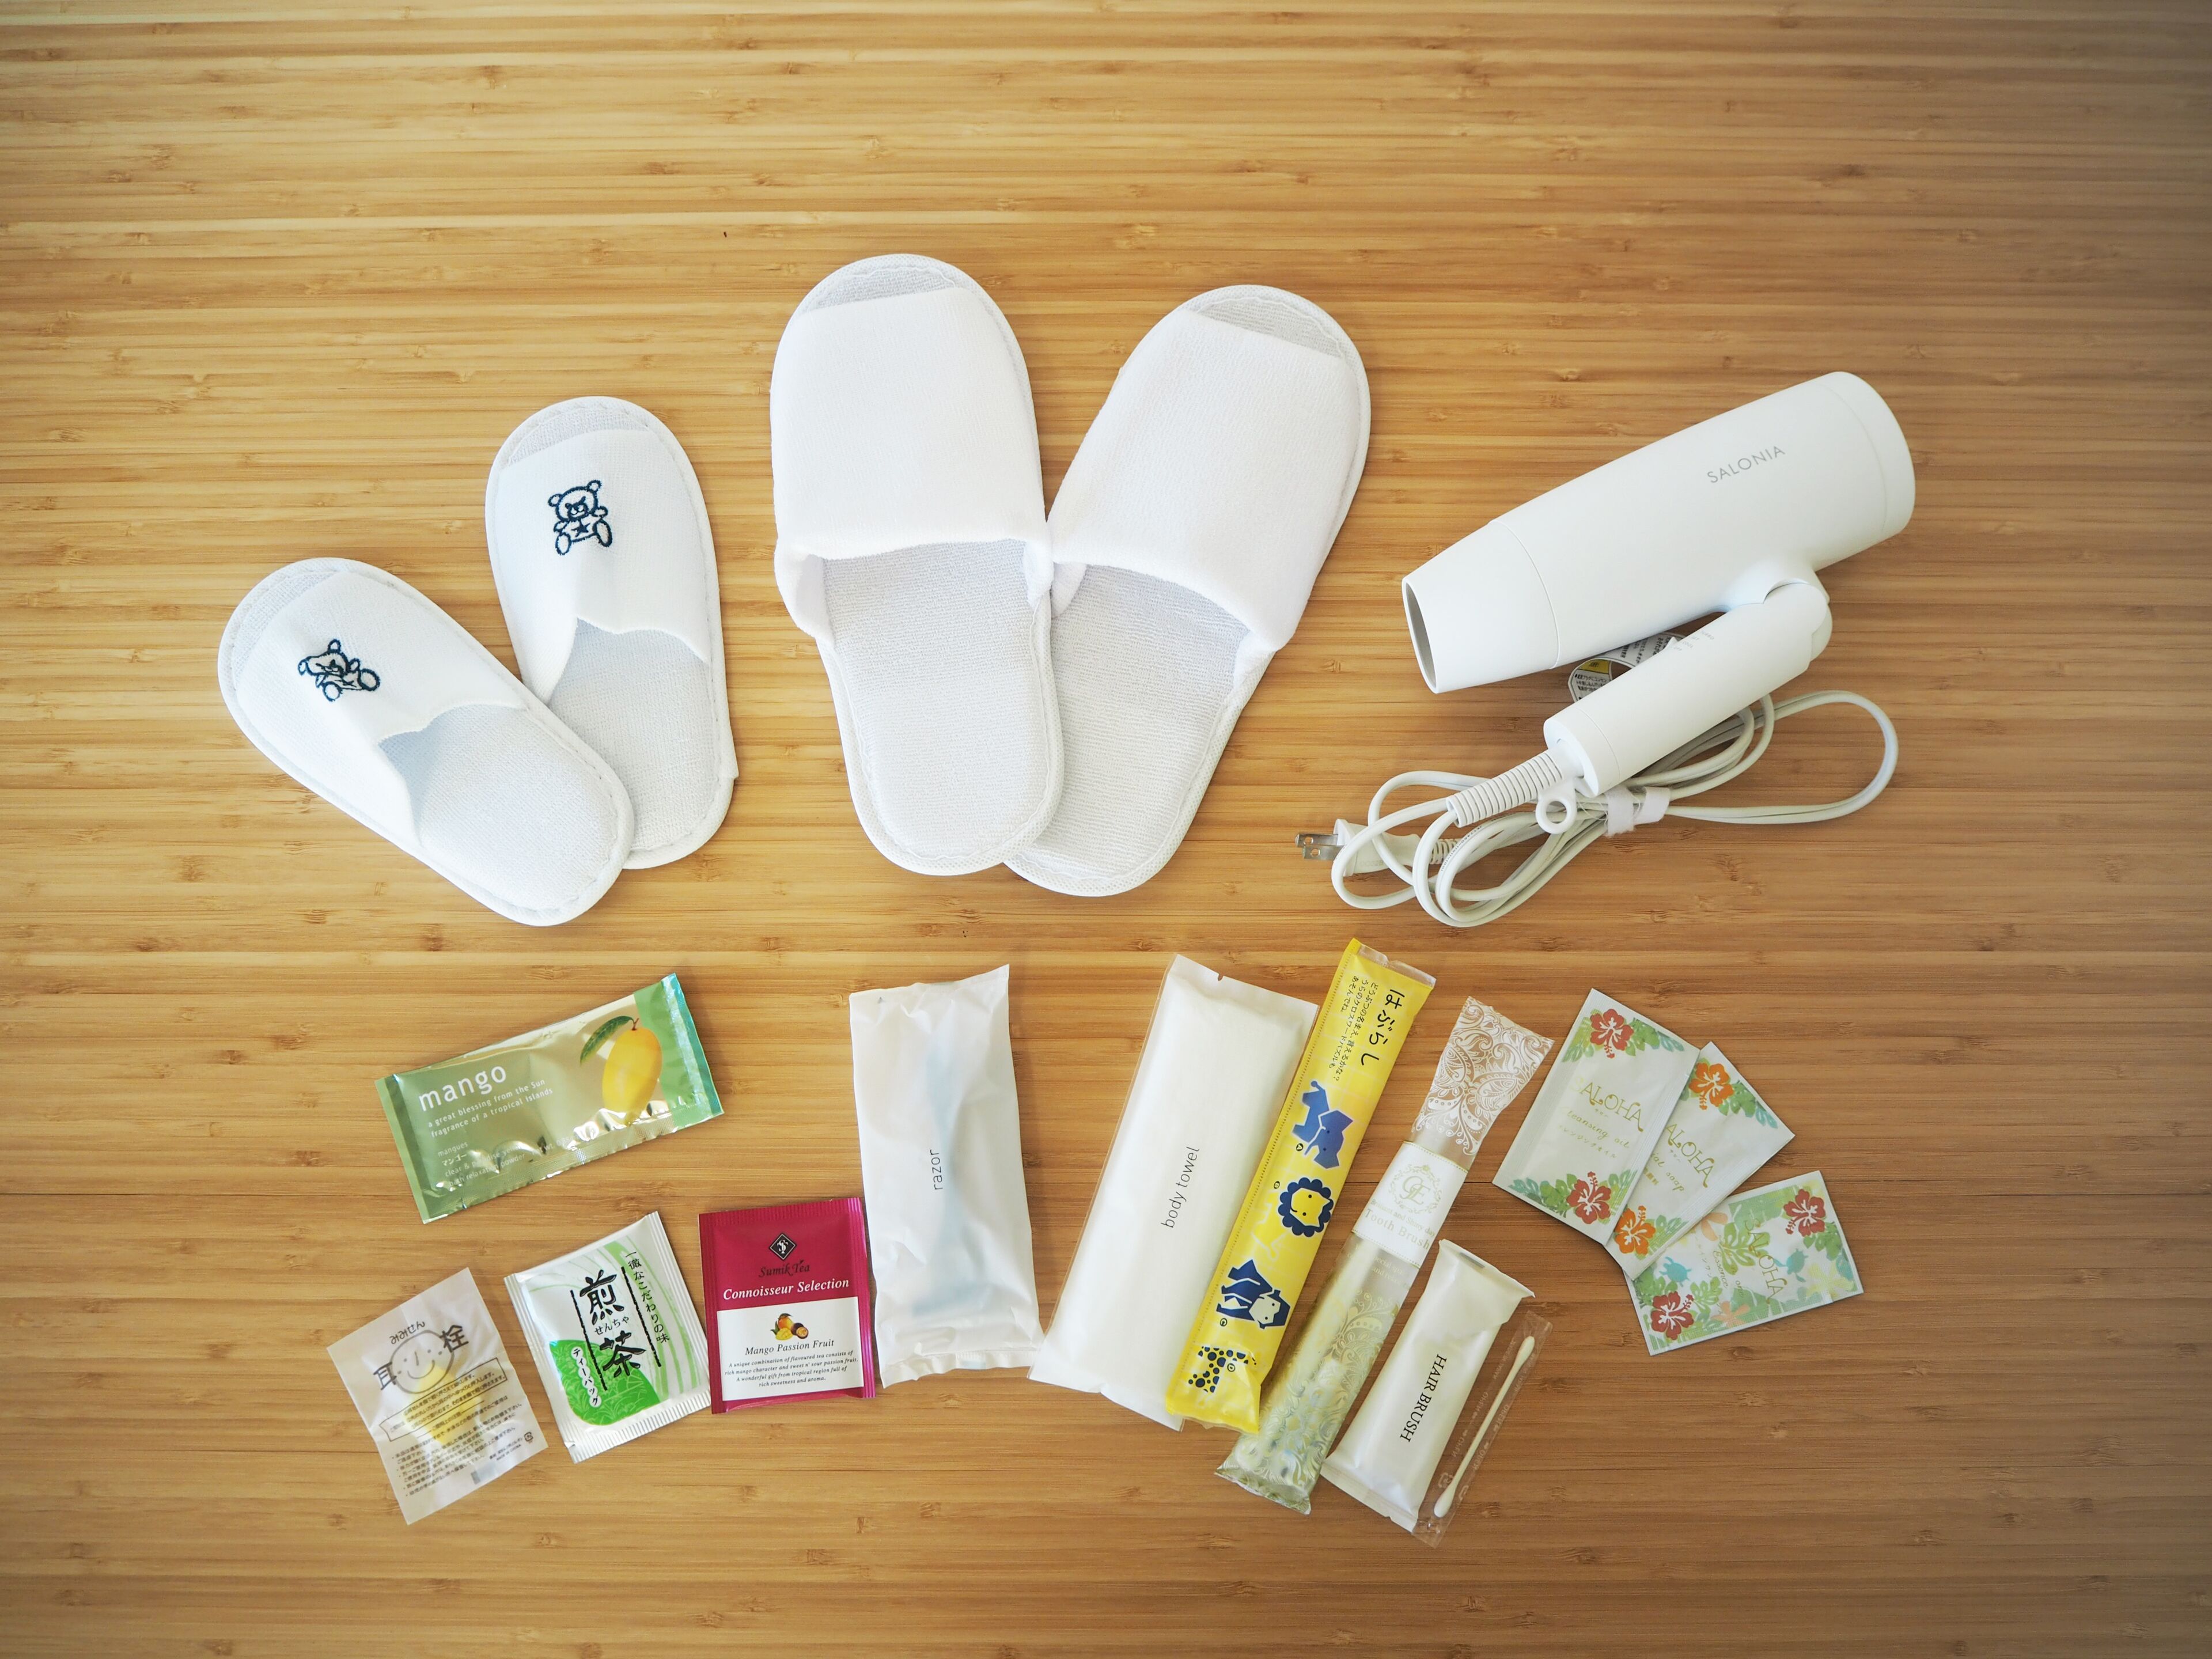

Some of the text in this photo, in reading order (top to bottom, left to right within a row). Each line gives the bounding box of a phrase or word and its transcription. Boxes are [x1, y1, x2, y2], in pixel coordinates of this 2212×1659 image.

[1707, 446, 1786, 483] SALONIA
[1329, 980, 1368, 1069] うらのクロスワードパズルも
[1361, 989, 1405, 1066] はぶらし
[419, 1066, 506, 1112] mango
[435, 1112, 456, 1126] great
[458, 1100, 491, 1116] blessing
[494, 1091, 513, 1102] from
[515, 1085, 529, 1094] the
[531, 1080, 546, 1089] Sun
[431, 1119, 468, 1138] fragrance
[471, 1113, 480, 1122] of
[490, 1099, 523, 1115] tropical
[438, 1142, 468, 1157] mangues
[442, 1153, 467, 1166] マンゴー
[1614, 1138, 1630, 1148] oil
[445, 1166, 461, 1177] clear
[500, 1153, 525, 1168] powder
[929, 1148, 943, 1191] razor
[1161, 1146, 1200, 1228] body towel
[1666, 1172, 1684, 1191] soap
[1363, 1208, 1430, 1249] Tooth Brush
[759, 1260, 810, 1278] Sumik Tea
[1713, 1250, 1728, 1289] Essence
[1745, 1218, 1787, 1305] SALOHA
[625, 1251, 670, 1344] 一徹なこだわりの味
[723, 1278, 850, 1301] Connoisseur Selection
[389, 1320, 425, 1345] みみせん
[441, 1324, 469, 1353] 栓
[594, 1315, 630, 1336] せんちゃ
[745, 1339, 835, 1355] Mango Passion Fruit
[751, 1357, 783, 1365] combination
[789, 1354, 815, 1363] flavoured
[573, 1347, 600, 1406] ティーバッグ
[741, 1374, 767, 1382] wonderful
[777, 1371, 790, 1379] from
[1400, 1353, 1448, 1442] HAIR BRUSH
